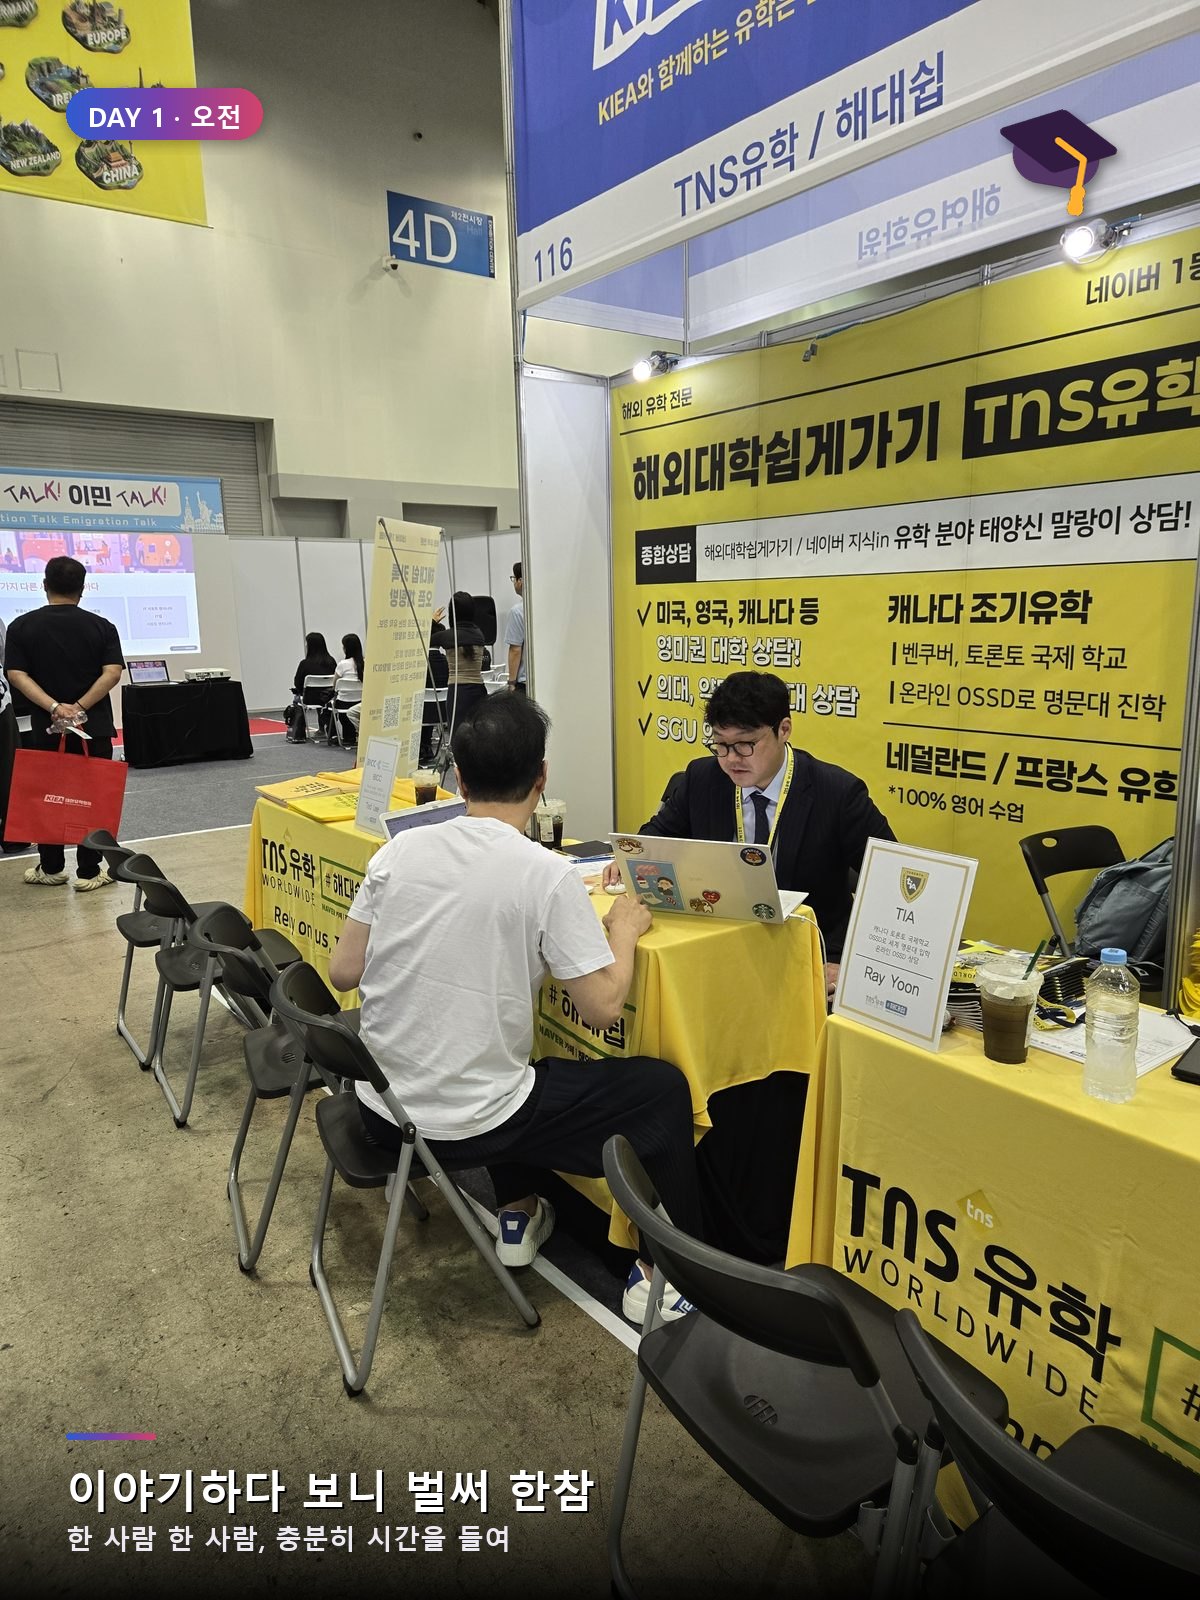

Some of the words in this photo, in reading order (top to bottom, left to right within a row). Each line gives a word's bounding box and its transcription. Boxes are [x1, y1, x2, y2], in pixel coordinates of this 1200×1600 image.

[87, 28, 127, 46] EUROPE
[597, 68, 653, 125] KIEA와
[657, 29, 729, 91] 함께하는
[52, 92, 72, 107] IRE
[673, 129, 801, 217] TNS유학
[835, 50, 947, 141] 해대쉽
[10, 158, 27, 170] NEW
[28, 151, 61, 164] ZEALAND
[102, 164, 139, 184] CHINA
[392, 209, 457, 264] 4D
[534, 237, 573, 283] 116
[1086, 262, 1161, 305] 네이버
[622, 400, 643, 420] 해외
[646, 393, 668, 415] 유학
[670, 386, 693, 408] 전문
[633, 401, 940, 500] 해외대학쉽게가기
[4, 480, 61, 503] TALK!
[68, 485, 112, 507] 이민
[116, 486, 167, 508] TALK!
[31, 513, 58, 524] Talk
[63, 515, 129, 527] Emigration
[134, 517, 157, 527] Talk
[704, 537, 793, 561] 해외대학쉽게가기
[806, 531, 845, 555] 네이버
[848, 531, 890, 551] 지식in
[894, 523, 930, 550] 유학
[935, 519, 974, 546] 분야
[979, 512, 1043, 543] 태양신
[1051, 505, 1122, 539] 말랑이
[1129, 500, 1192, 534] 상담!
[640, 542, 692, 566] 종합상담
[656, 600, 691, 628] 미국,
[695, 599, 734, 628] 영국,
[738, 598, 794, 625] 캐나다
[799, 597, 820, 625] 등
[888, 592, 964, 625] 캐나다
[969, 589, 1093, 625] 조기유학
[656, 635, 706, 663] 영미권
[711, 637, 748, 665] 대학
[752, 637, 802, 667] 상담!
[902, 643, 958, 668] 벤쿠버,
[965, 645, 1025, 668] 토론토
[1031, 645, 1075, 671] 국제
[1082, 645, 1128, 672] 학교
[656, 675, 694, 706] 의대,
[788, 683, 807, 714] 대
[812, 685, 860, 718] 상담
[899, 682, 950, 707] 온라인
[957, 686, 1036, 711] OSSD로
[1044, 689, 1110, 718] 명문대
[1117, 693, 1166, 722] 진학
[656, 716, 697, 744] SGU
[886, 742, 987, 781] 네덜란드
[1014, 756, 1108, 797] 프랑스
[951, 795, 984, 817] 영어
[988, 800, 1024, 824] 수업
[262, 873, 316, 907] WORLDWIDE
[274, 905, 296, 936] Rely
[298, 920, 313, 940] on
[315, 928, 332, 954] us,
[896, 906, 915, 925] TIA
[864, 965, 886, 985] Ray
[890, 973, 920, 997] Yoon
[966, 1198, 994, 1230] tns
[974, 1244, 1122, 1384] 유학
[843, 1246, 1100, 1424] WORLDWIDE
